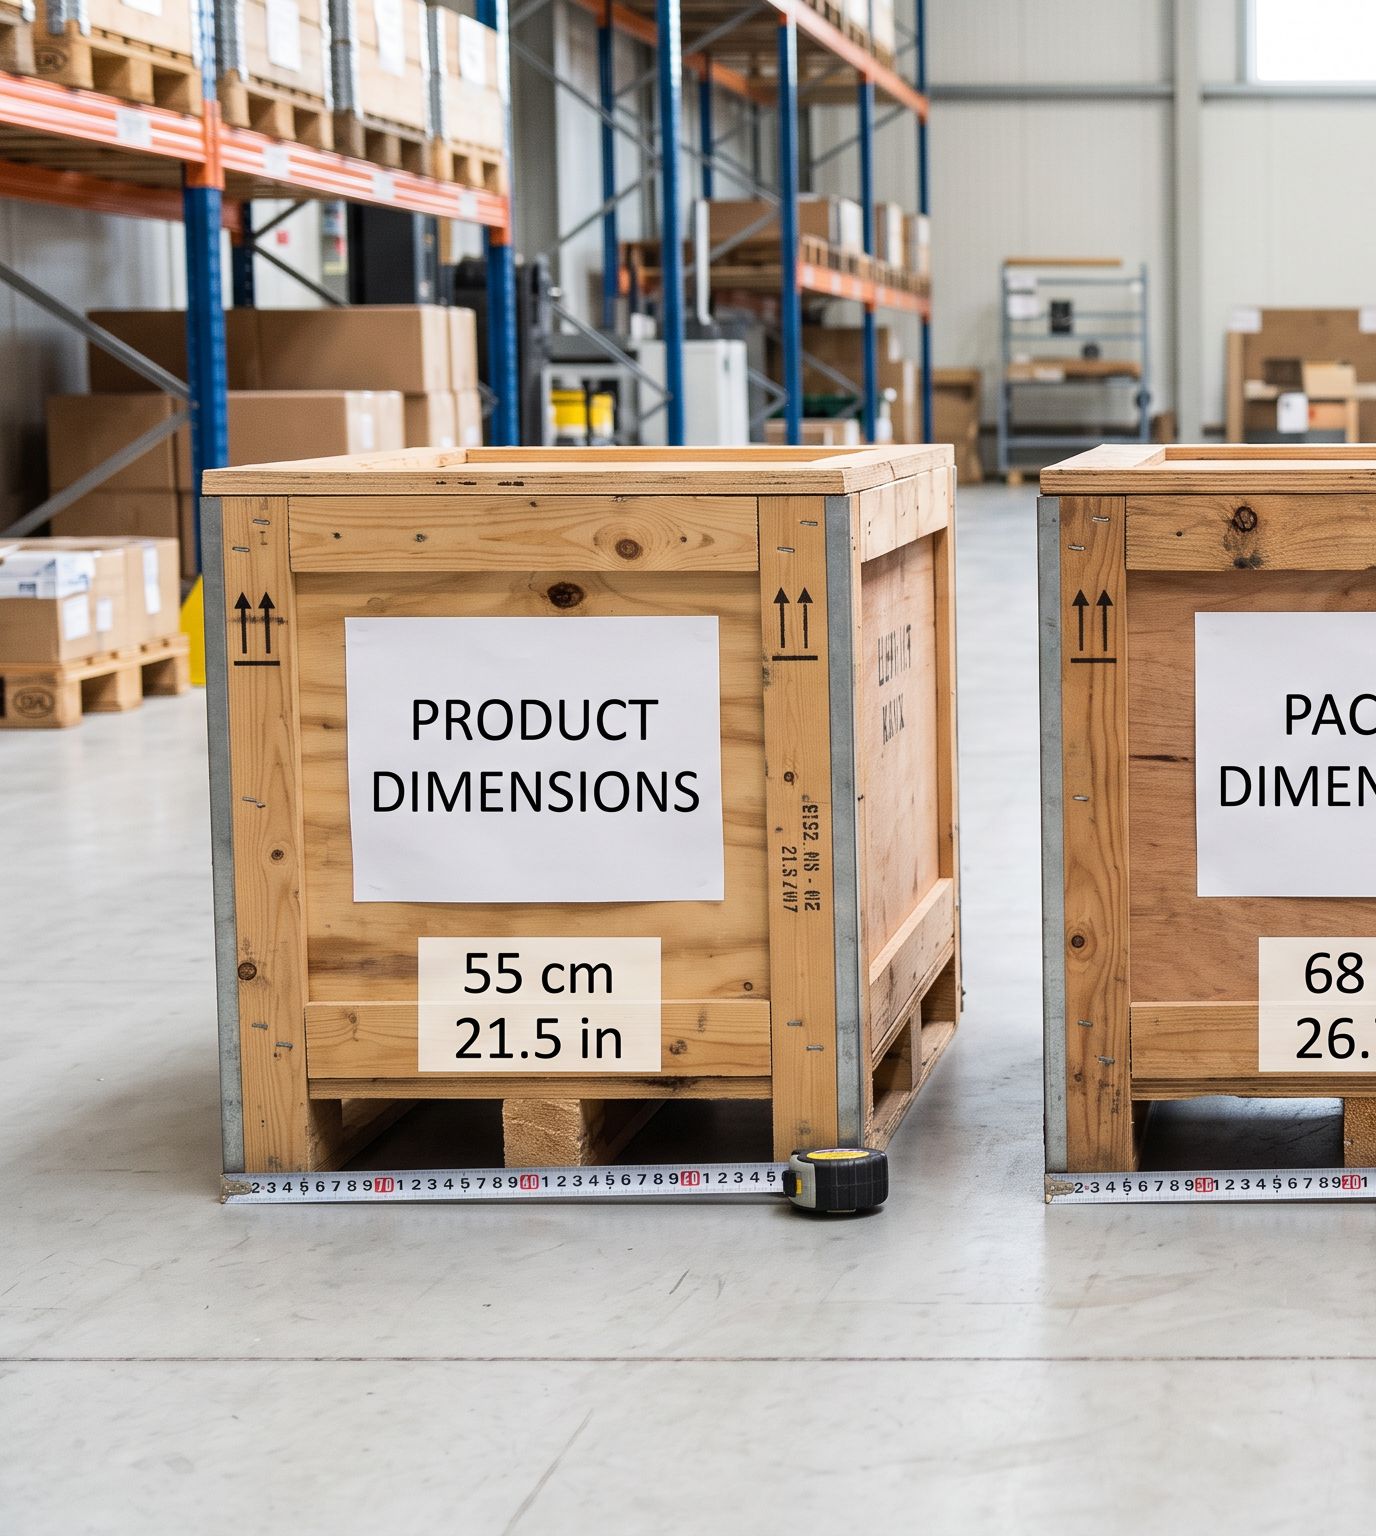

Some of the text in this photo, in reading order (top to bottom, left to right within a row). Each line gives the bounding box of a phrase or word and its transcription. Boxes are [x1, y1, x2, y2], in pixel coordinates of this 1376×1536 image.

[412, 698, 659, 742] PRODUCT
[372, 769, 701, 814] DIMENSIONS
[266, 1181, 277, 1194] 3
[281, 1181, 293, 1194] 4
[299, 1181, 309, 1194] 5
[315, 1180, 326, 1193] 6
[331, 1180, 341, 1193] 7
[347, 1179, 357, 1192] 8
[362, 1179, 373, 1192] 9
[396, 1179, 403, 1192] 1
[411, 1178, 422, 1191] 2
[427, 1178, 438, 1191] 3
[443, 1177, 454, 1190] 4
[460, 1177, 471, 1190] 5
[476, 1177, 486, 1190] 7
[492, 1176, 503, 1189] 8
[507, 1176, 518, 1189] 9
[541, 1175, 549, 1188] 1
[556, 1175, 567, 1188] 2
[572, 1174, 583, 1187] 3
[588, 1174, 600, 1187] 4
[605, 1174, 615, 1187] 5
[621, 1173, 631, 1186] 6
[636, 1173, 647, 1186] 7
[653, 1172, 664, 1185] 8
[668, 1172, 679, 1185] 9
[702, 1172, 710, 1185] 1
[717, 1172, 728, 1185] 2
[733, 1171, 744, 1184] 3
[749, 1171, 760, 1184] 4
[766, 1170, 776, 1183] 5
[1074, 1181, 1084, 1194] 2
[1090, 1181, 1100, 1194] 3
[1105, 1181, 1116, 1194] 4
[1122, 1180, 1132, 1193] 5
[1138, 1180, 1148, 1193] 6
[1153, 1180, 1164, 1193] 7
[1169, 1179, 1180, 1192] 8
[1184, 1179, 1195, 1192] 9
[1212, 1179, 1219, 1192] 1
[1224, 1178, 1235, 1191] 2
[1240, 1178, 1251, 1191] 3
[1255, 1178, 1267, 1191] 4
[1272, 1178, 1282, 1191] 5
[1287, 1177, 1298, 1190] 6
[1303, 1177, 1313, 1190] 7
[1318, 1176, 1329, 1189] 8
[1331, 1176, 1342, 1189] 9
[1360, 1176, 1368, 1189] 1
